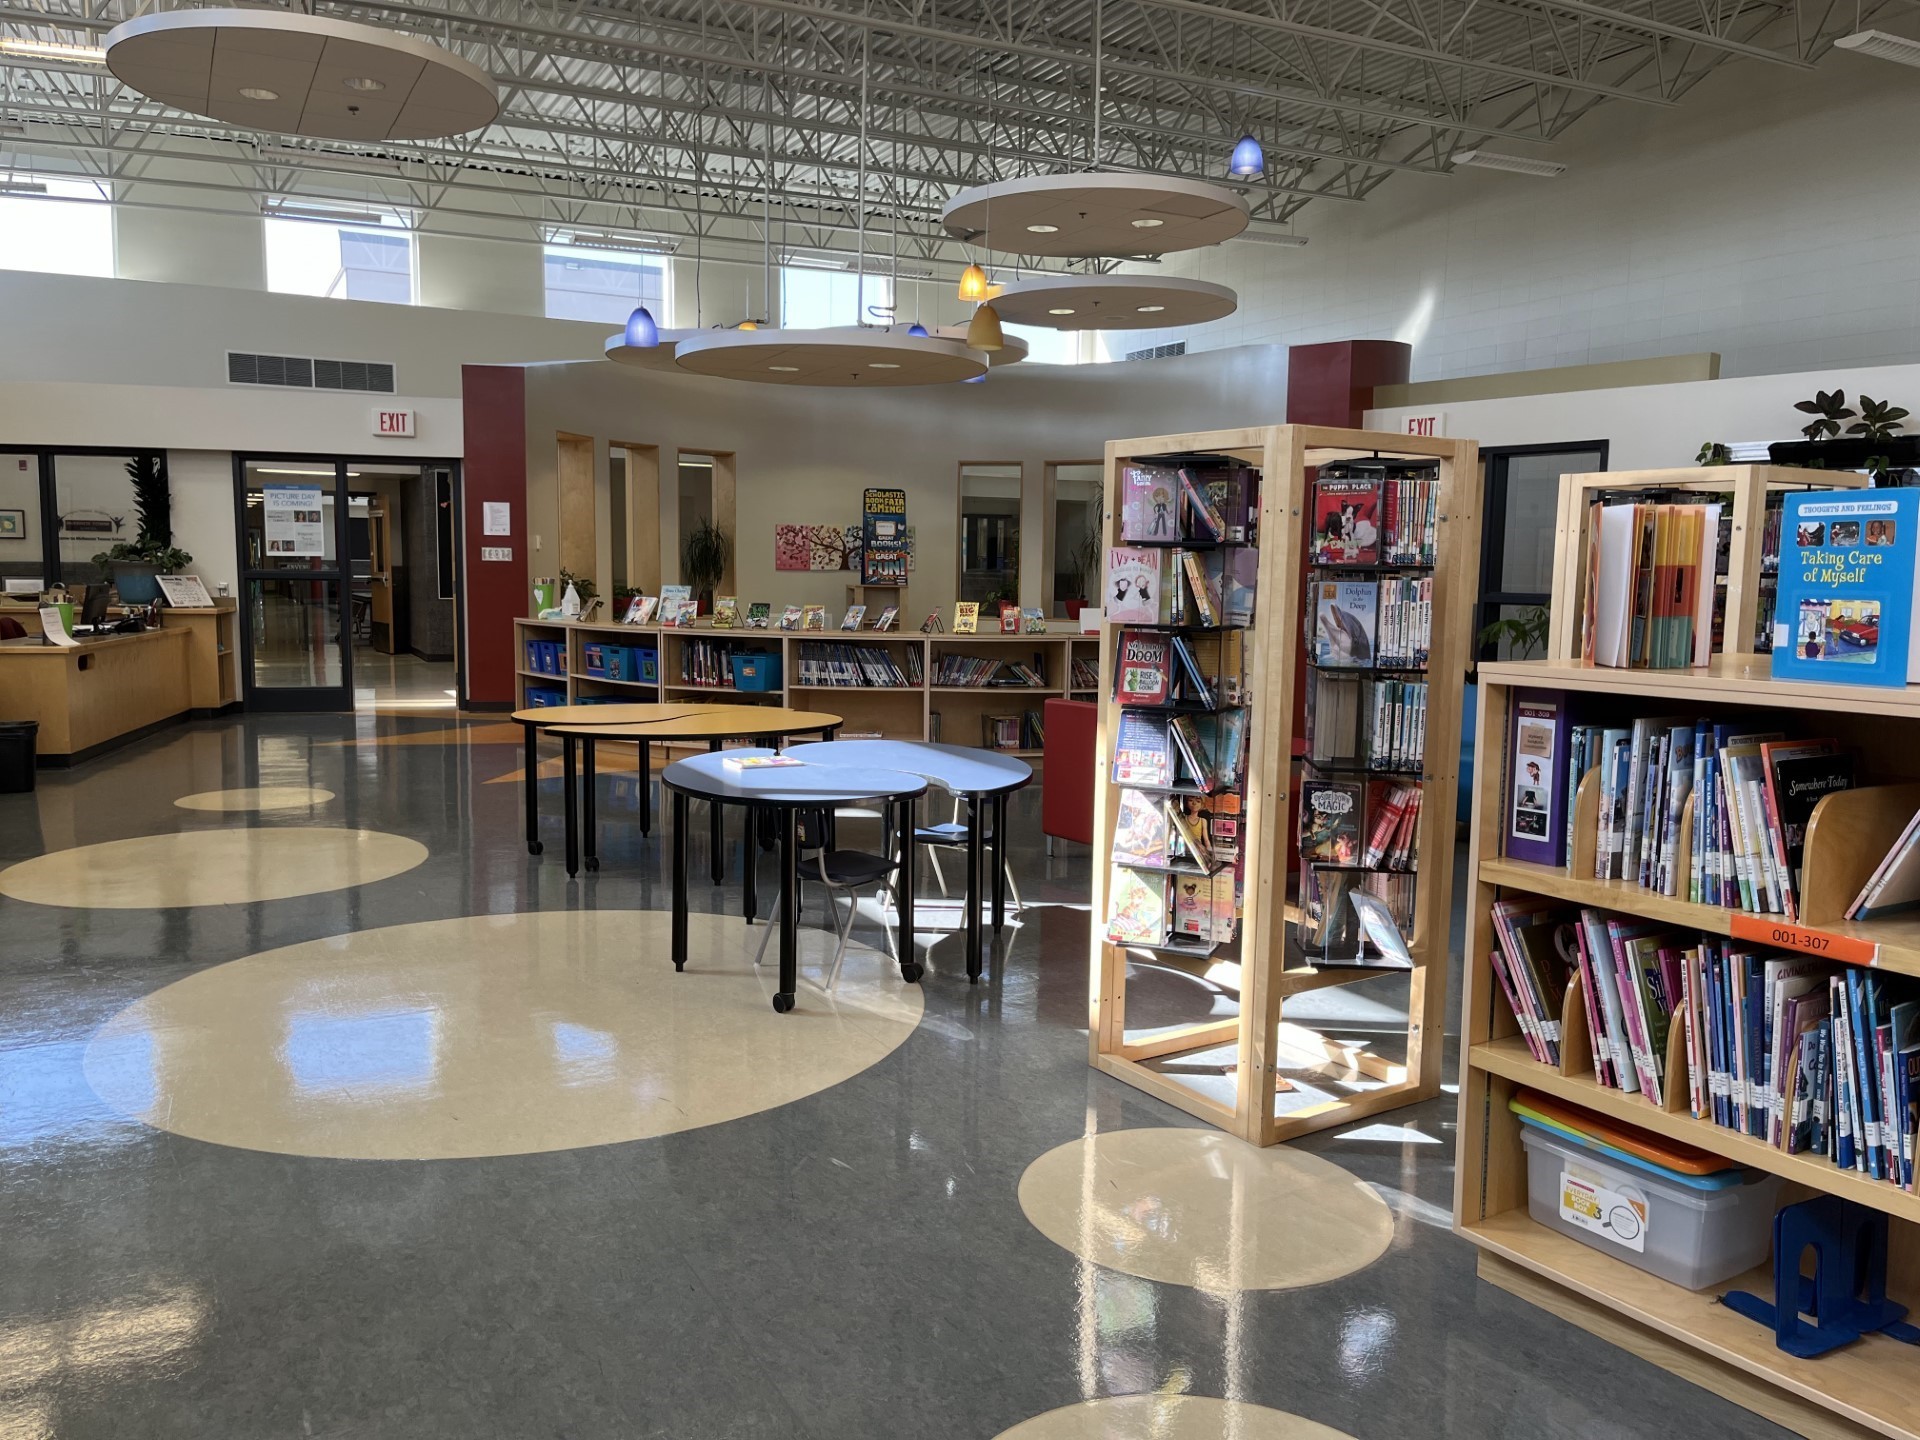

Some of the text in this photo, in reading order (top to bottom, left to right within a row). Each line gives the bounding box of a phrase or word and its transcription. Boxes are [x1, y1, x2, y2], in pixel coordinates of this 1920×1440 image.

[380, 412, 408, 432] EXIT
[1408, 417, 1436, 436] EXIT
[866, 504, 904, 513] COMING!
[1857, 503, 1892, 512] FEELINGS
[868, 558, 905, 576] FUN!
[1138, 550, 1158, 570] BEAN
[1801, 551, 1882, 571] Taking Care
[1803, 568, 1866, 588] of Myself
[1346, 588, 1372, 596] Dolphin
[1350, 602, 1366, 611] Deep
[1127, 649, 1162, 662] DOOM
[1789, 776, 1848, 796] Somewhere Today
[1318, 802, 1346, 811] MAGIC
[1739, 814, 1745, 822] AN
[1772, 929, 1829, 950] 001-307
[1777, 964, 1804, 980] GIVING
[1820, 1028, 1826, 1038] We
[1566, 1185, 1597, 1201] EVERYDAY
[1571, 1194, 1590, 1208] BOOK
[1573, 1202, 1588, 1213] BOX
[1593, 1206, 1603, 1220] 3
